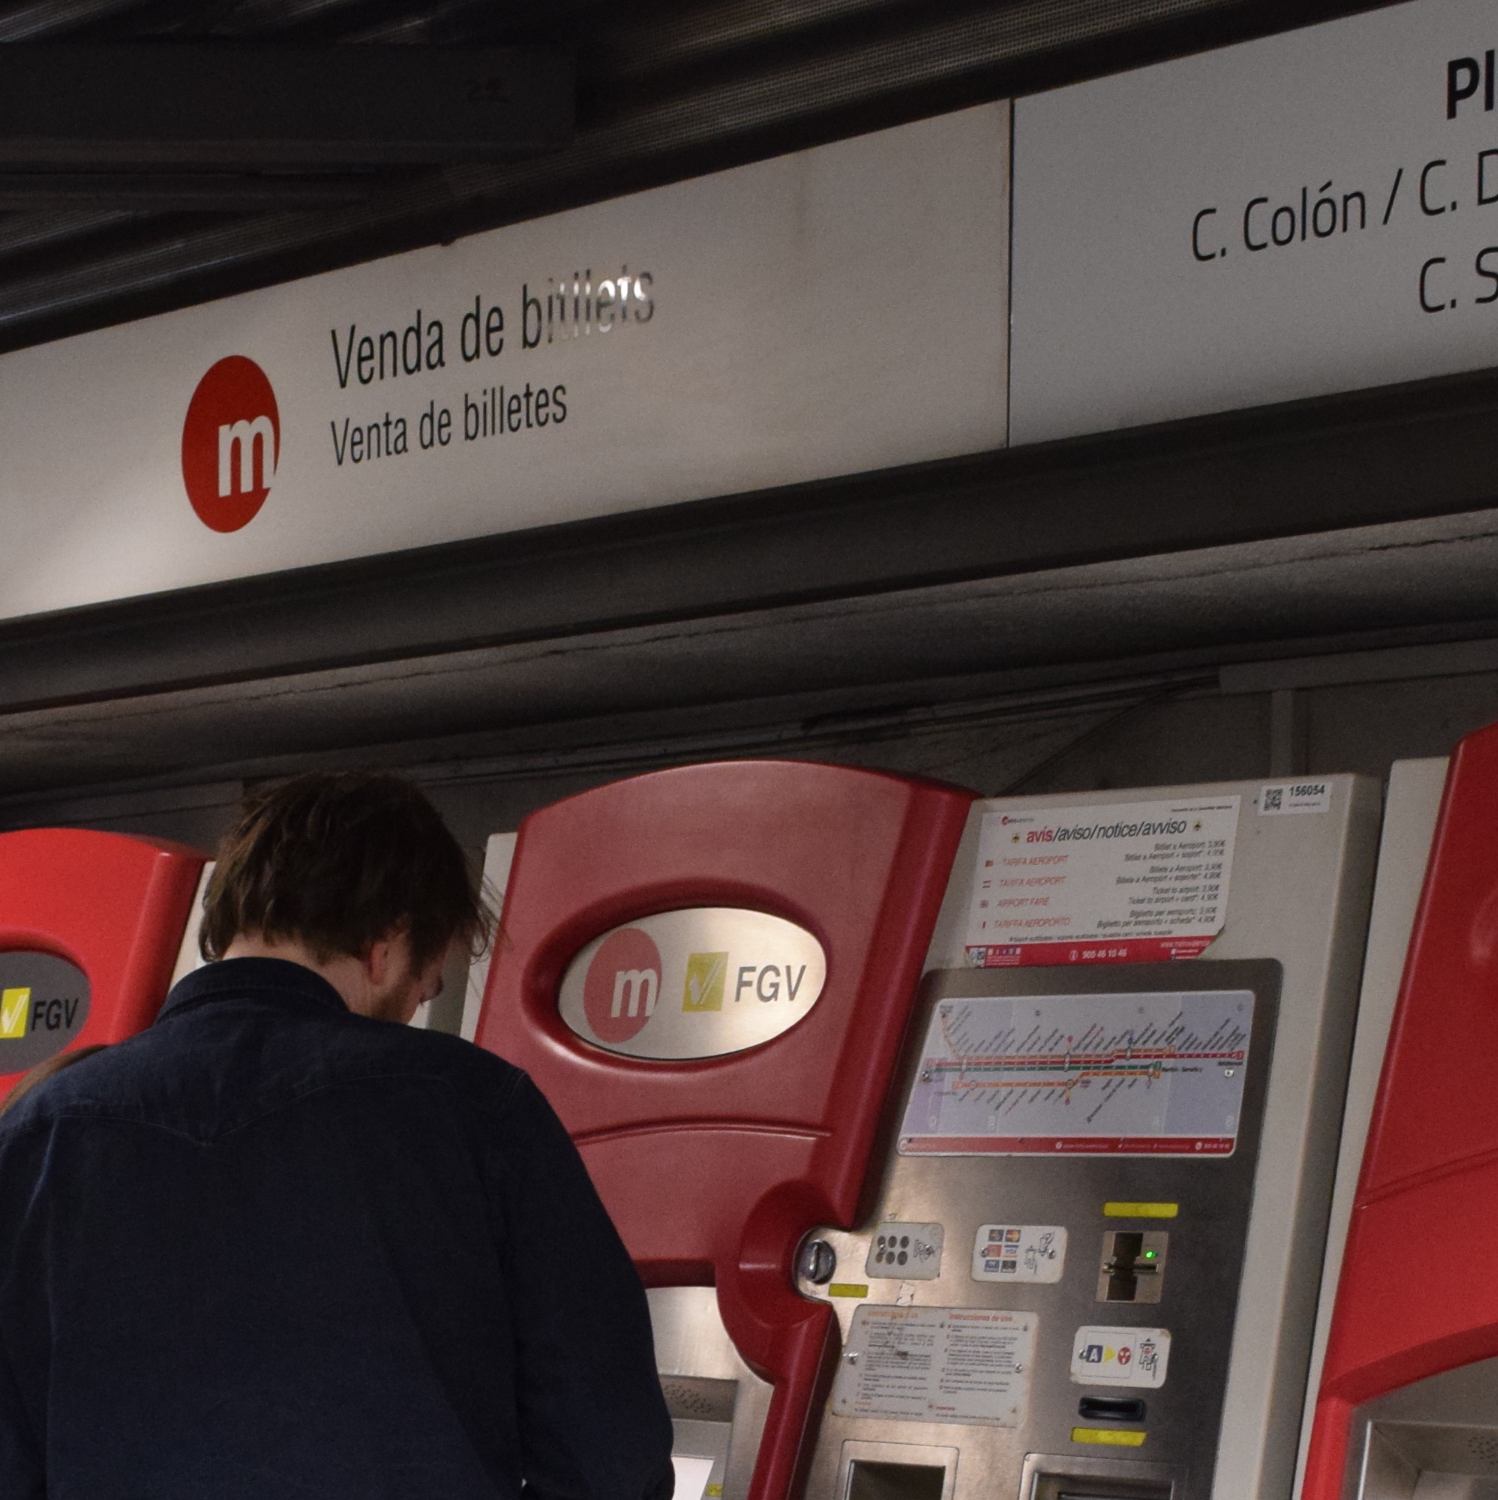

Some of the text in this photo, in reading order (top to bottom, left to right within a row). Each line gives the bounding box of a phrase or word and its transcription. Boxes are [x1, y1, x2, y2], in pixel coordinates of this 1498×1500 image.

[1193, 209, 1226, 262] C.
[1244, 184, 1365, 252] Colón
[1382, 168, 1403, 224] /
[1419, 160, 1457, 216] C.
[1419, 258, 1457, 314] C.
[331, 309, 444, 389] Venda
[460, 296, 503, 361] de
[331, 385, 567, 466] Venta de billetes
[217, 414, 275, 498] m
[1290, 785, 1325, 796] 156054
[611, 968, 658, 1017] m
[735, 965, 807, 1003] FGV
[31, 998, 78, 1032] FGV
